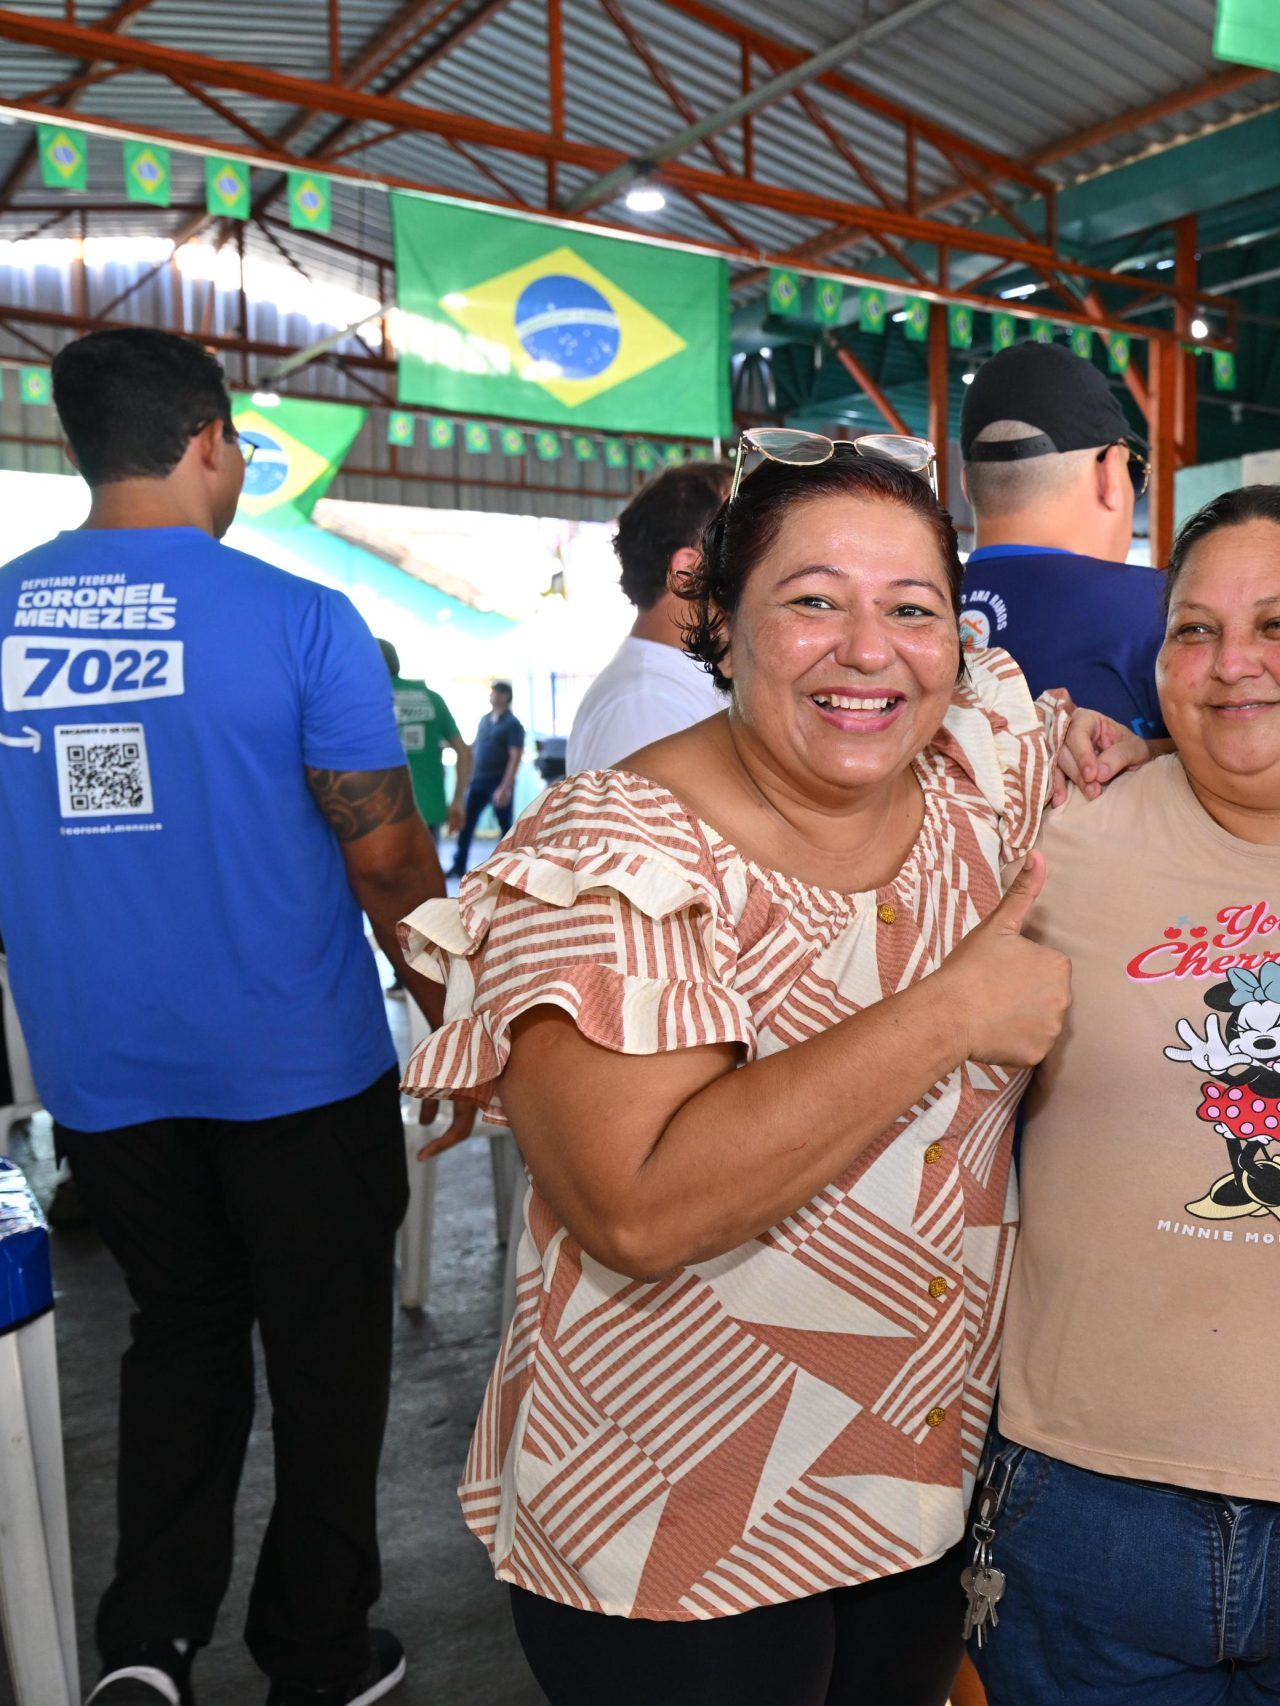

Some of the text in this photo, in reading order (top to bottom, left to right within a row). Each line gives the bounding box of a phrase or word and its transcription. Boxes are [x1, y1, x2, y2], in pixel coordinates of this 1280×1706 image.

[21, 573, 127, 591] DEPUTADO FEDERAL
[17, 582, 178, 608] CORONEL
[14, 606, 177, 631] MENEZES
[969, 590, 991, 603] ANA
[988, 594, 1008, 631] RAMOS
[23, 647, 169, 698] 7022
[1157, 1219, 1234, 1242] MINNIE
